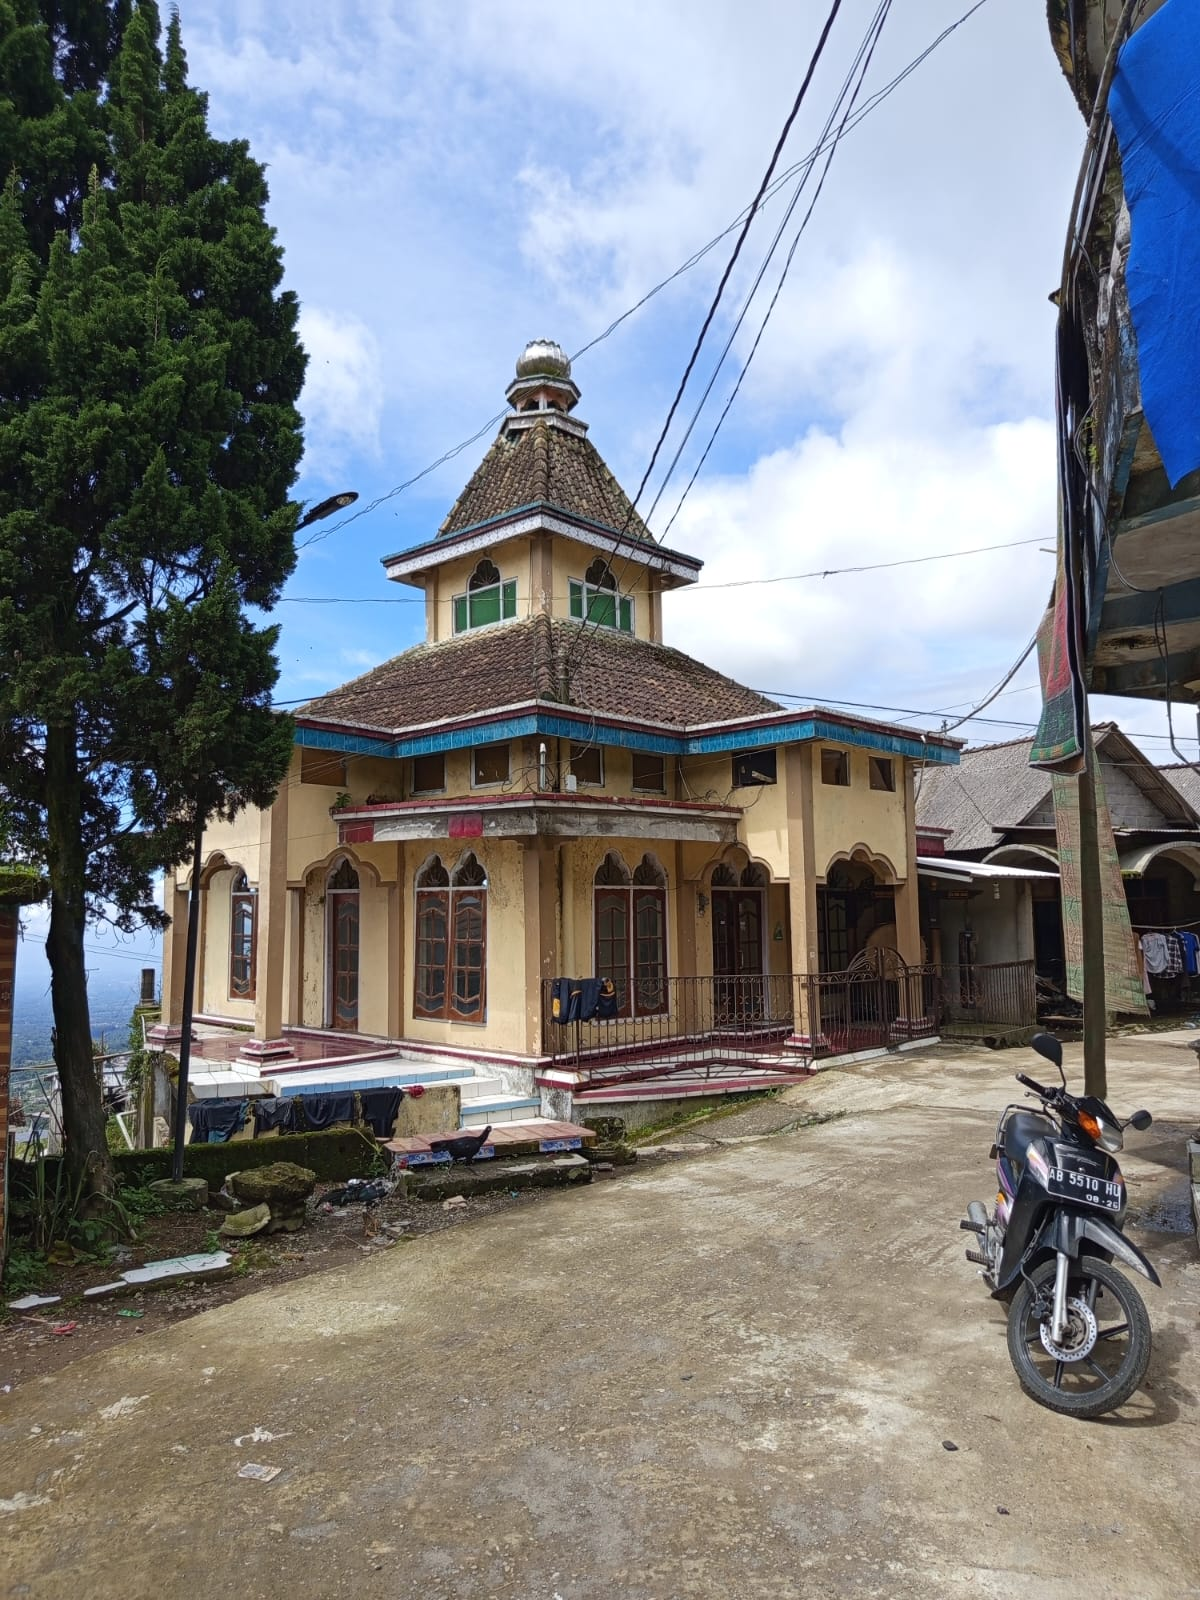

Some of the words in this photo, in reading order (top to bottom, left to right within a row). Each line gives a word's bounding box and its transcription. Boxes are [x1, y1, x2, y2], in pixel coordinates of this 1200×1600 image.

[1049, 1168, 1063, 1182] AB
[1069, 1173, 1098, 1191] 5510
[1105, 1183, 1120, 1197] HU
